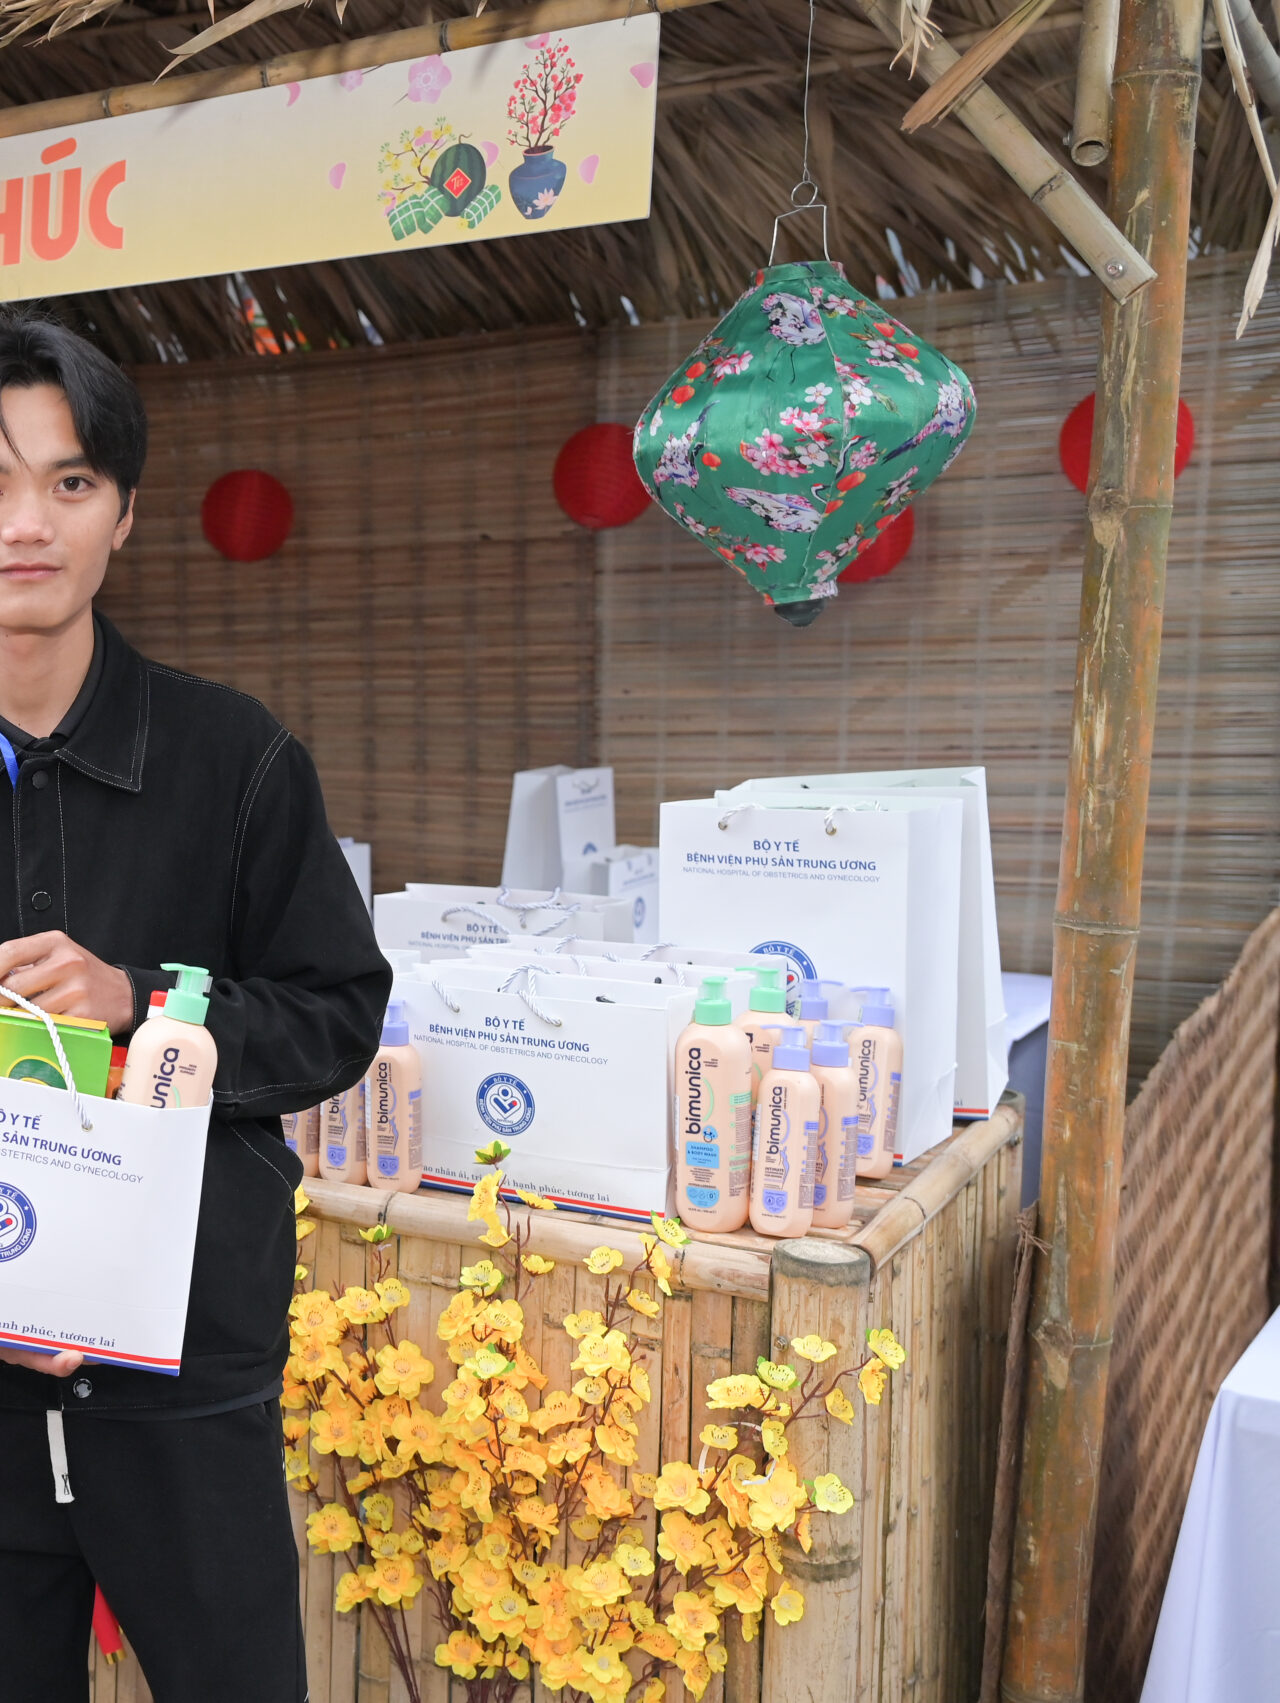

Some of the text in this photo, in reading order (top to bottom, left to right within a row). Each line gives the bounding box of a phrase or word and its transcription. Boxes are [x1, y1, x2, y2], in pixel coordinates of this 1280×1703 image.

[753, 839, 800, 854] BỘ Y TẾ
[687, 852, 877, 871] BỆNH VIỆN PHỤ SẢN TRUNG ƯƠNG
[683, 866, 881, 884] NATIONAL HOSPITAL OF OBSTETRICS AND GYNECOLOGY
[485, 1016, 526, 1031] BỘ Y TẾ
[414, 1033, 609, 1065] NATIONAL HOSPITAL OF OBSTETRICS AND GYNECOLOGY
[430, 1023, 590, 1053] BỆNH VIỆN PHỤ SẢN TRUNG ƯƠNG
[150, 1047, 180, 1109] unica
[377, 1062, 389, 1124] bimunica
[686, 1047, 702, 1135] bimunica
[954, 1098, 964, 1107] ai
[9, 1112, 21, 1127] Y
[23, 1114, 43, 1131] TẾ
[766, 1086, 783, 1155] bimunica
[2, 1129, 30, 1147] SẢN
[32, 1137, 78, 1157] TRUNG
[81, 1147, 122, 1167] ƯƠNG
[50, 1157, 72, 1170] AND
[73, 1162, 144, 1185] GYNECOLOGY
[435, 1165, 457, 1178] nhân
[6, 1189, 20, 1200] TẾ
[513, 1179, 537, 1192] hạnh
[539, 1183, 566, 1196] phúc,
[567, 1189, 595, 1201] tương
[597, 1193, 610, 1202] lai
[1, 1246, 21, 1259] TRUNG
[22, 1322, 57, 1339] phúc,
[60, 1329, 97, 1347] tương
[99, 1336, 116, 1348] lai
